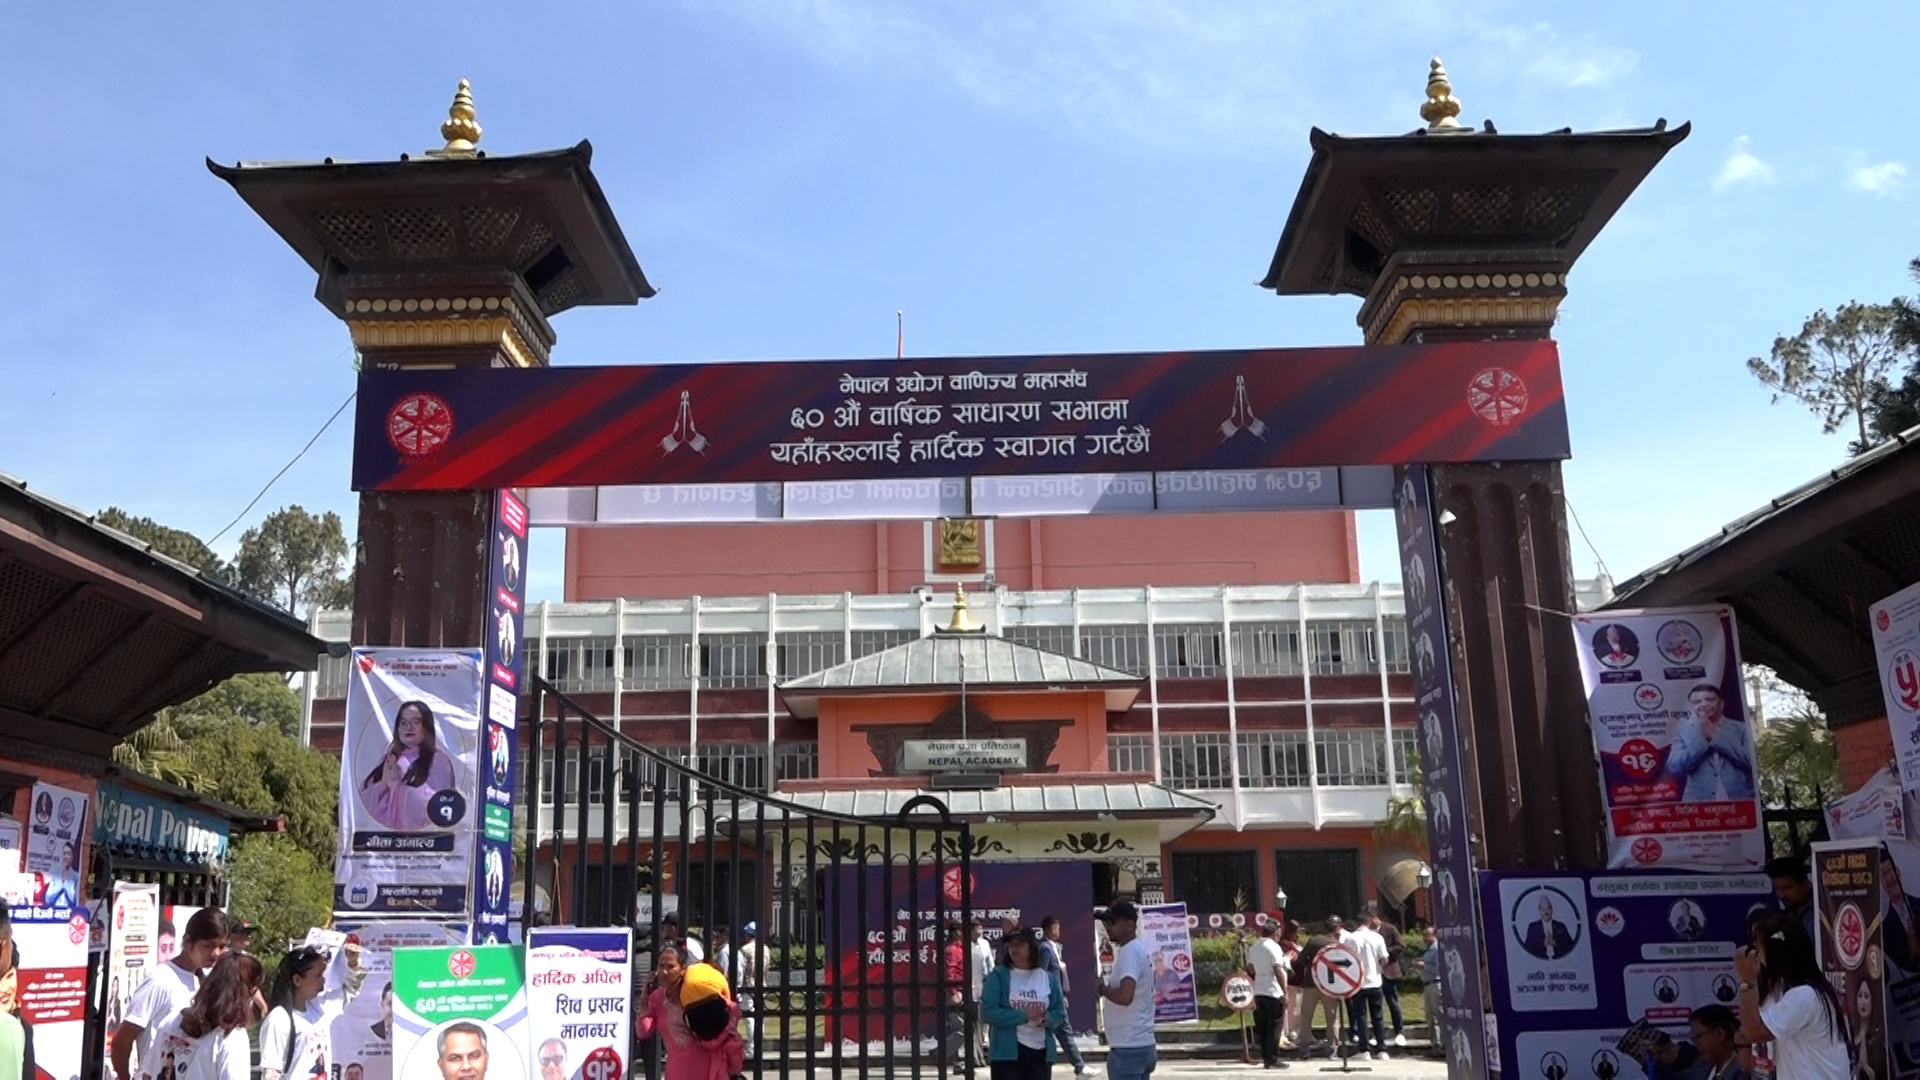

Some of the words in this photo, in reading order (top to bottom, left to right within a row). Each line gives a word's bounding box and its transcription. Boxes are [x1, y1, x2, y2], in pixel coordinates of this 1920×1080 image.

[839, 373, 890, 394] नेपाल
[895, 371, 944, 392] उद्योग
[949, 370, 1018, 390] वाणिज्य
[1023, 368, 1088, 390] महासंघ
[791, 407, 825, 429] ६०
[834, 397, 862, 428] औं
[869, 397, 943, 426] वार्षिक
[951, 401, 1042, 424] साधारण
[1050, 399, 1130, 422] सभामा
[909, 430, 985, 463] हार्दिक
[993, 434, 1076, 458] स्वागत
[1084, 424, 1151, 455] गर्दछौं
[928, 757, 963, 766] NEPAL
[966, 756, 1020, 765] ACADEMY
[96, 789, 152, 842] Nepal
[158, 808, 221, 855] Police
[532, 969, 577, 987] हार्दिक
[582, 967, 622, 984] अपिल
[556, 993, 583, 1015] शिव
[588, 997, 625, 1015] प्रसाद
[560, 1022, 619, 1039] मानन्धर
